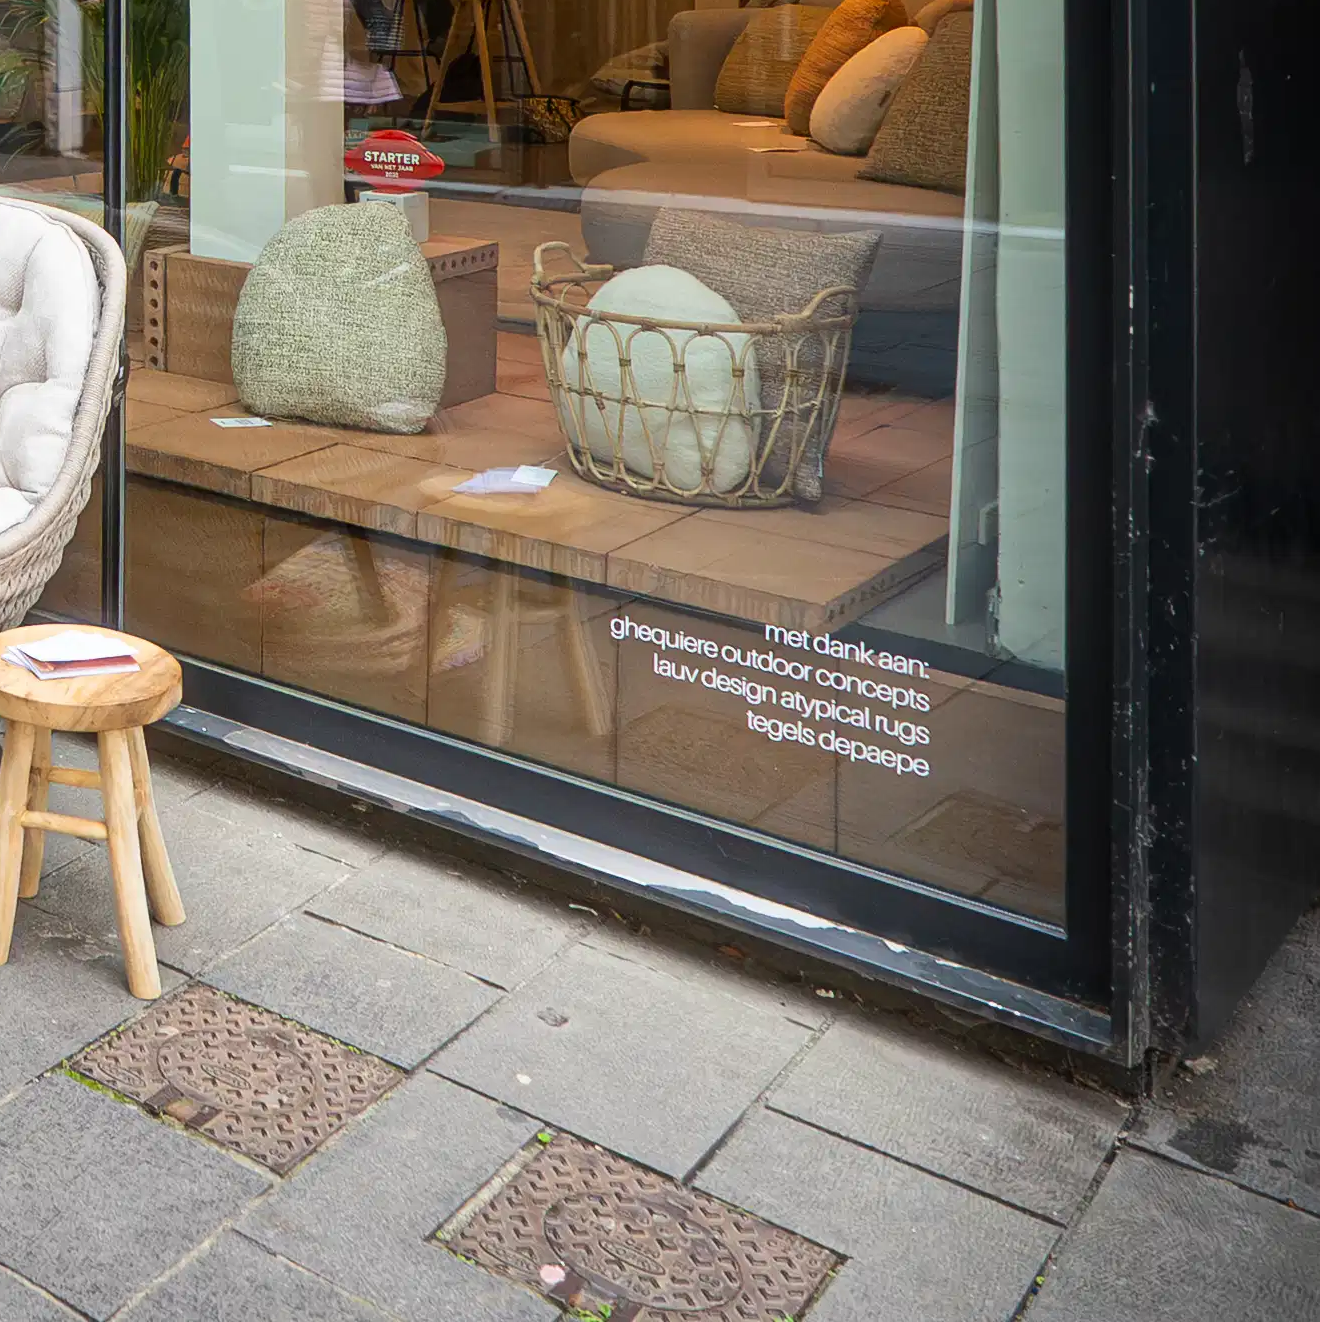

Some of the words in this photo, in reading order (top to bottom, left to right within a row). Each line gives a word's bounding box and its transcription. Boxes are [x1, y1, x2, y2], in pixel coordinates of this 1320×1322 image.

[364, 150, 420, 166] STARTER
[610, 615, 719, 659] ghequiere
[721, 644, 814, 682] outdoor
[815, 668, 931, 713] concepts
[764, 623, 811, 651] met
[812, 633, 876, 667] dank
[878, 651, 931, 679] aan:
[652, 652, 700, 683] lauv
[700, 667, 777, 705] design
[780, 691, 872, 731] atypical
[875, 714, 931, 746] rugs
[746, 709, 816, 747] tegels
[818, 729, 931, 777] depaepe
